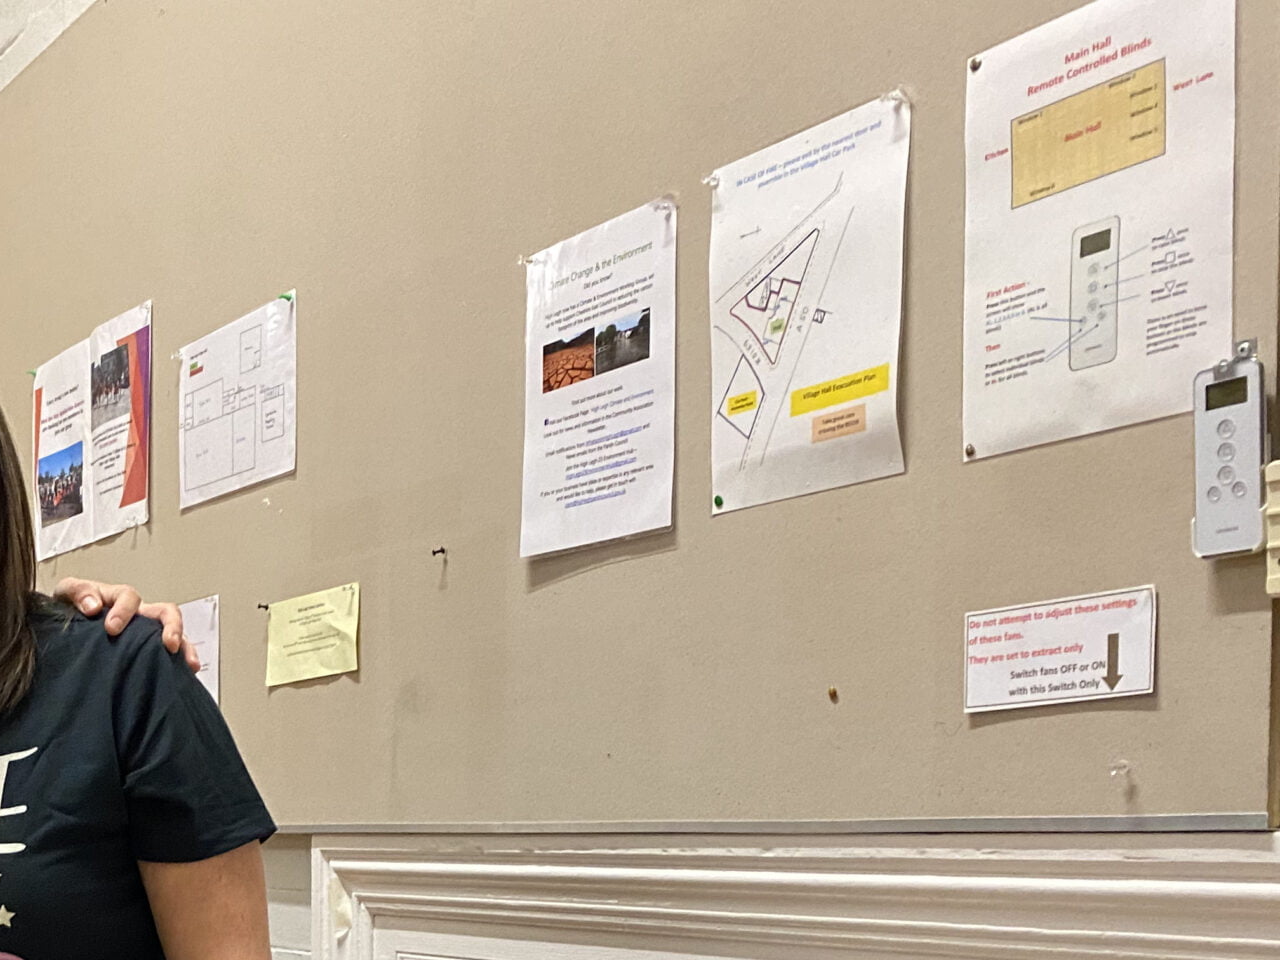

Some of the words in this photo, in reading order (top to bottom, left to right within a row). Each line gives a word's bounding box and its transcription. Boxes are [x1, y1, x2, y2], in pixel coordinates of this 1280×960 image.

[1064, 49, 1089, 64] Main
[1092, 36, 1111, 51] Hall
[1027, 76, 1064, 96] Remote
[1066, 50, 1118, 79] Controlled
[1121, 37, 1152, 57] Blinds
[986, 289, 1001, 298] First
[1003, 282, 1025, 293] Action
[985, 344, 1001, 352] Then
[821, 386, 832, 394] Hall
[833, 377, 863, 392] Evacuation
[969, 620, 981, 629] Do
[983, 618, 997, 628] not
[999, 613, 1032, 627] attempt
[1034, 611, 1044, 620] to
[1045, 606, 1073, 620] adjust
[1074, 603, 1099, 615] these
[1102, 598, 1137, 611] settings
[969, 634, 978, 646] of
[980, 634, 1002, 645] these
[1004, 631, 1024, 641] fans.
[969, 654, 988, 665] They
[990, 654, 1004, 662] are
[1006, 650, 1019, 661] set
[1021, 650, 1030, 659] to
[1031, 645, 1062, 658] extract
[1064, 643, 1084, 655] only
[1010, 668, 1038, 680] Switch
[1040, 666, 1059, 676] fans
[1060, 663, 1078, 674] OFF
[1079, 663, 1089, 671] or
[1091, 661, 1106, 670] ON
[1009, 685, 1028, 697] with
[1030, 683, 1046, 694] this
[1048, 681, 1078, 693] Switch
[1079, 679, 1101, 690] Only
